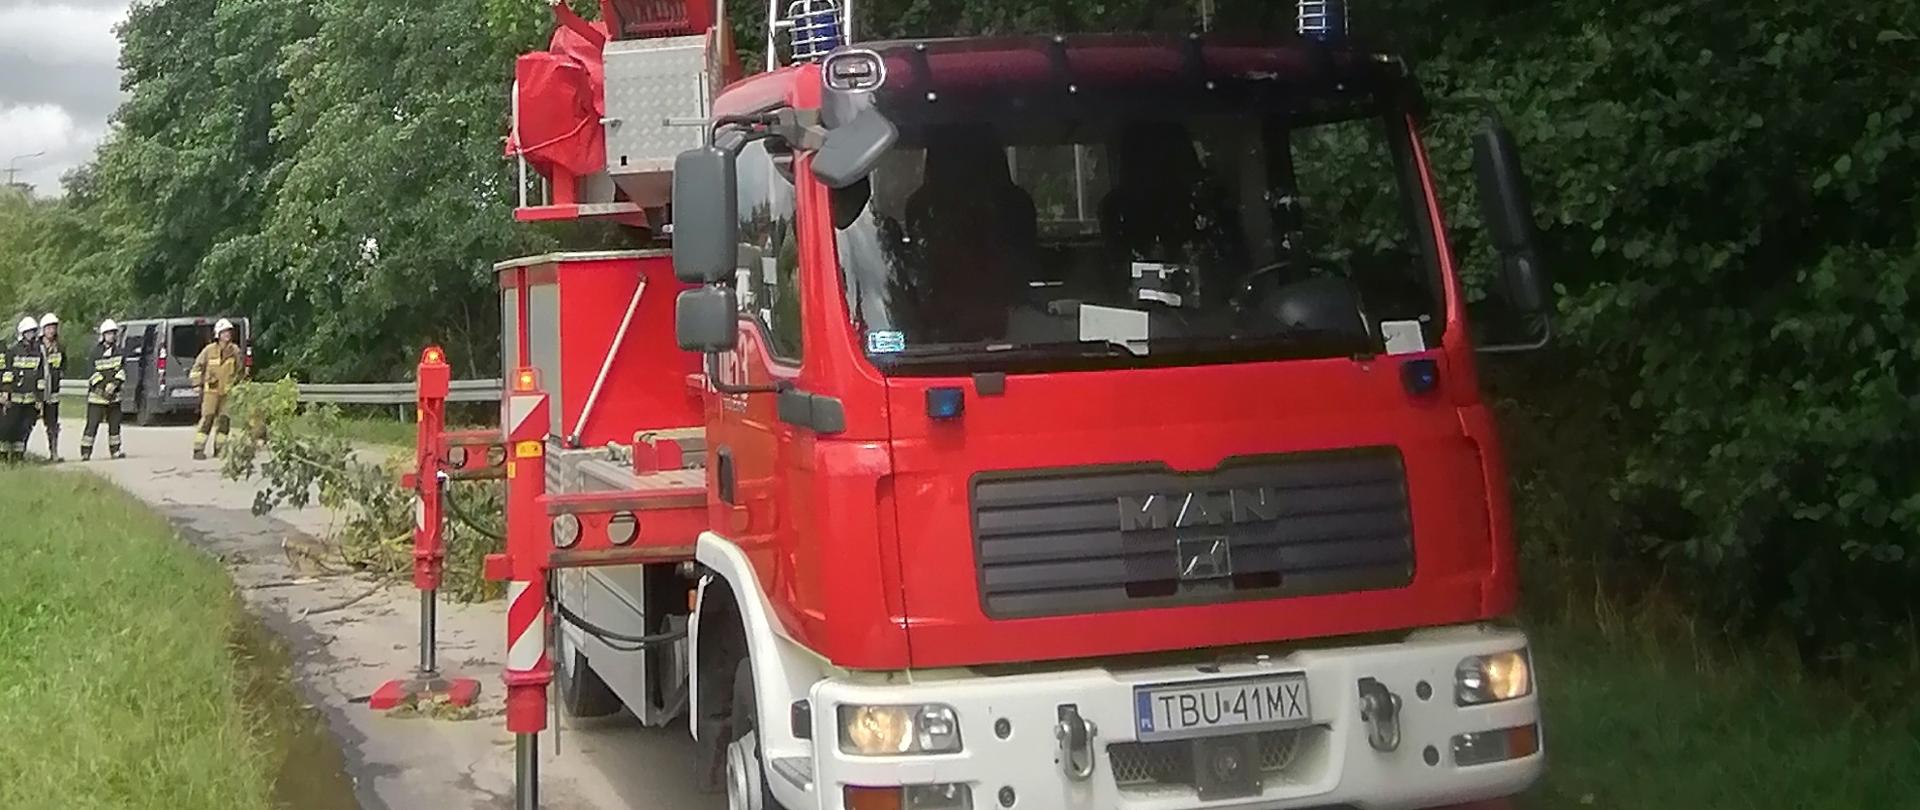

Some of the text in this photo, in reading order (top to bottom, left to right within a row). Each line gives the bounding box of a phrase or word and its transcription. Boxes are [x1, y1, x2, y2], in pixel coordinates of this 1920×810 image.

[1118, 488, 1279, 531] MAN
[1158, 684, 1303, 729] TBU 41MX
